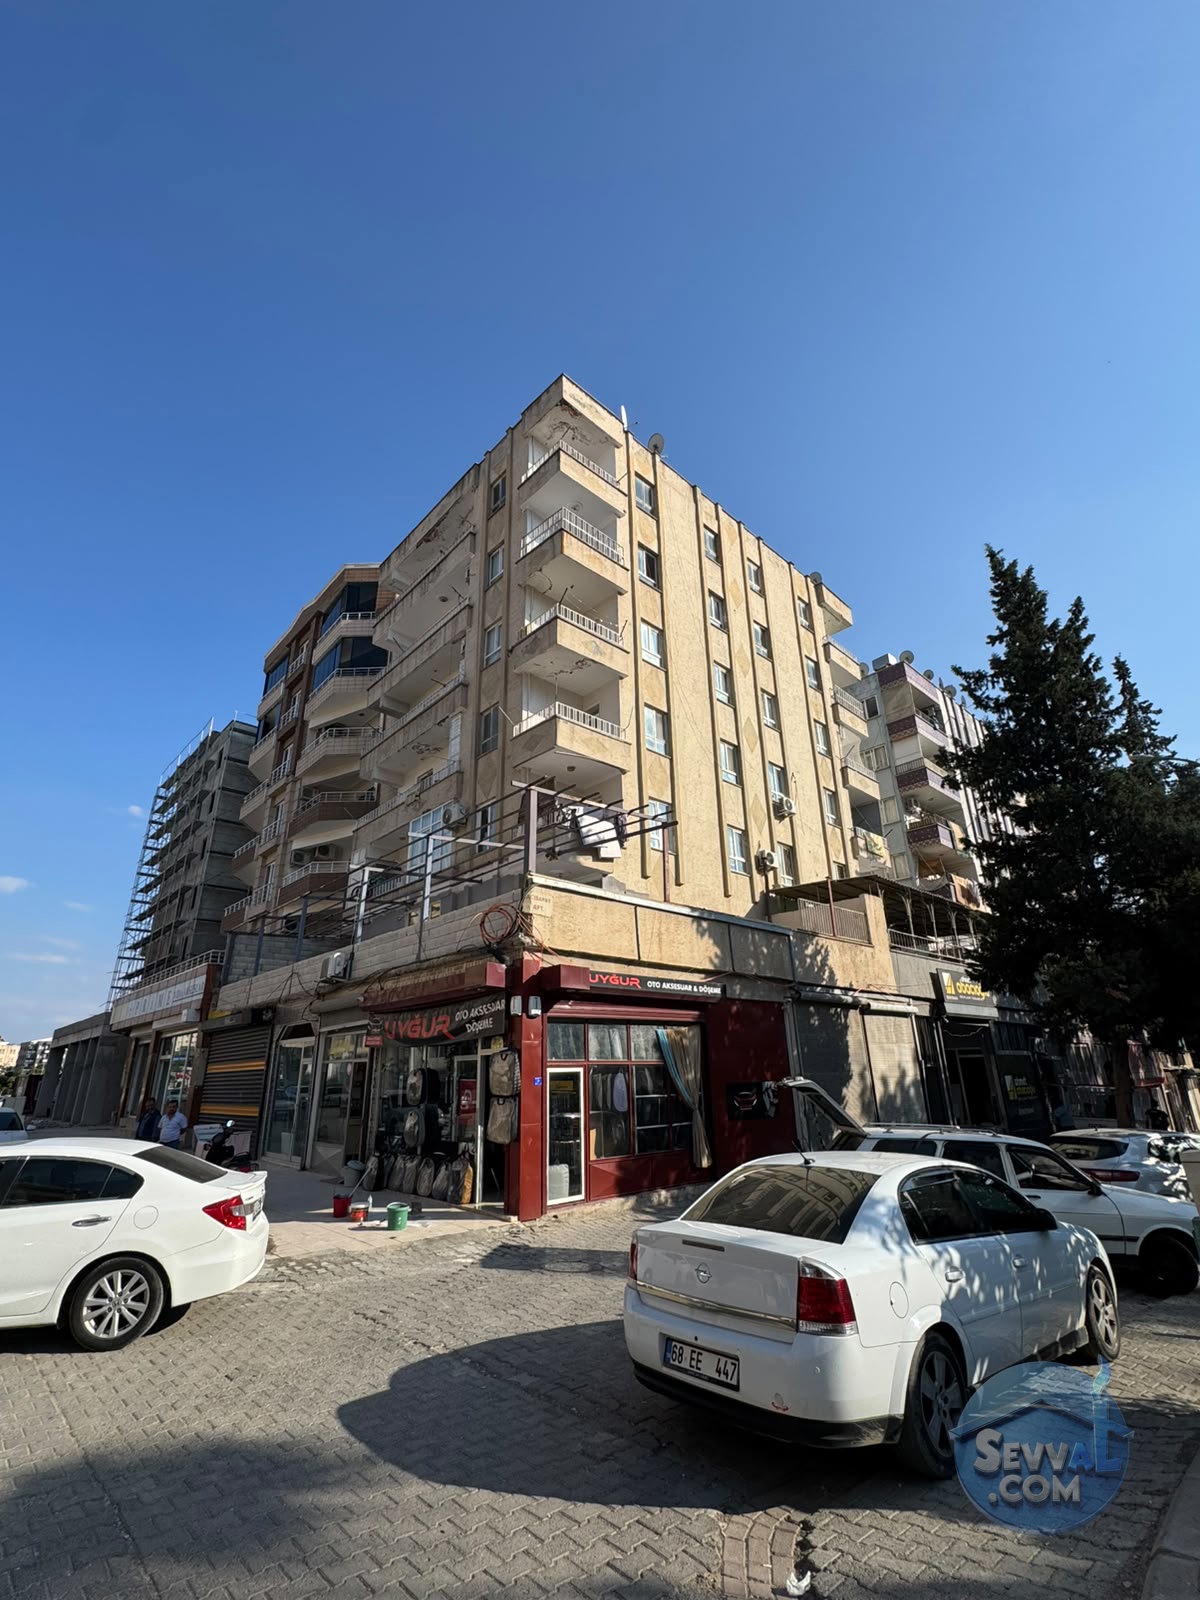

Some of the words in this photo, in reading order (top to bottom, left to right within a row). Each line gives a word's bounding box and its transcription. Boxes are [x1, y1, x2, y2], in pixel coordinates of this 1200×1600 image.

[647, 980, 661, 989] OTO
[662, 982, 692, 992] AKSESUAR
[693, 985, 698, 993] &
[699, 984, 721, 995] DÖŞEME
[384, 1014, 456, 1040] UYĞUR
[455, 1009, 469, 1022] OTO
[469, 999, 506, 1020] AKSESUAR
[465, 1017, 493, 1033] DÖŞEME
[671, 1343, 684, 1364] 68
[689, 1349, 703, 1371] EE
[715, 1358, 737, 1381] 447
